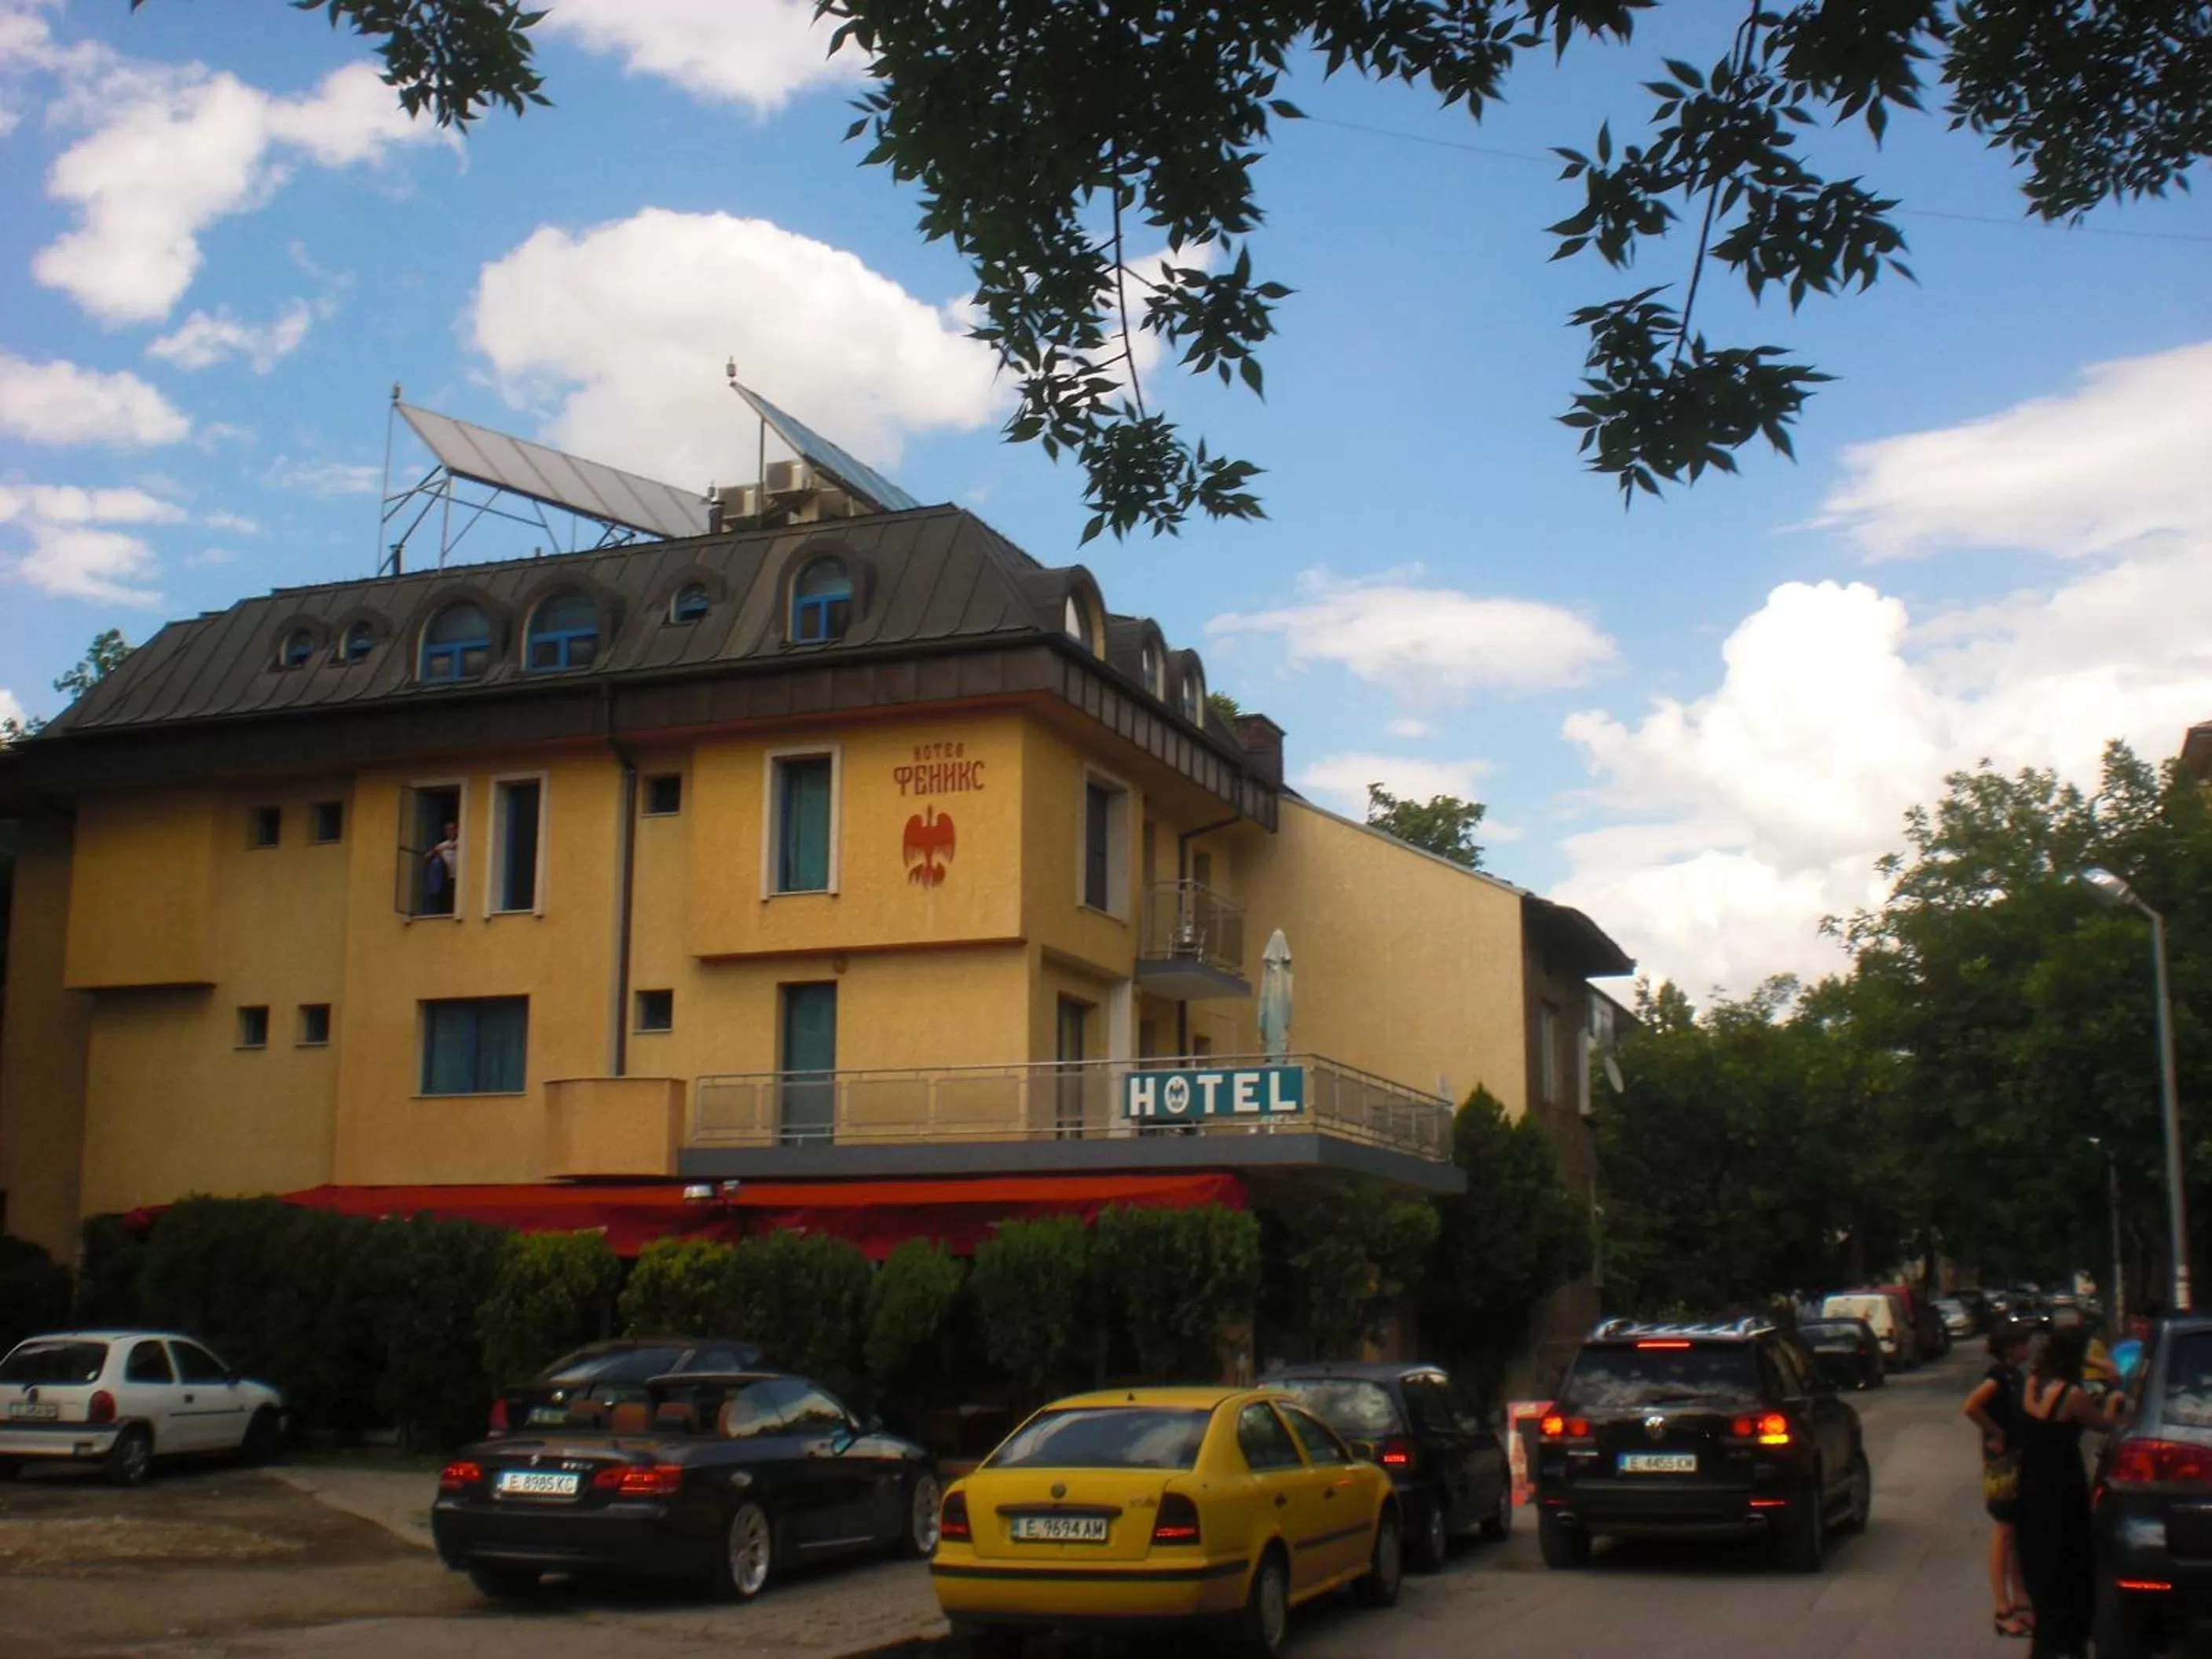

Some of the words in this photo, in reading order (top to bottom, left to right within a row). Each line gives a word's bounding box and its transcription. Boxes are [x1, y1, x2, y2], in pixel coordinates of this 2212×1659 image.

[893, 760, 986, 797] ФЕНИКС
[1129, 1071, 1297, 1116] HOTEL
[1026, 1519, 1035, 1536] E
[1043, 1518, 1080, 1536] 9694
